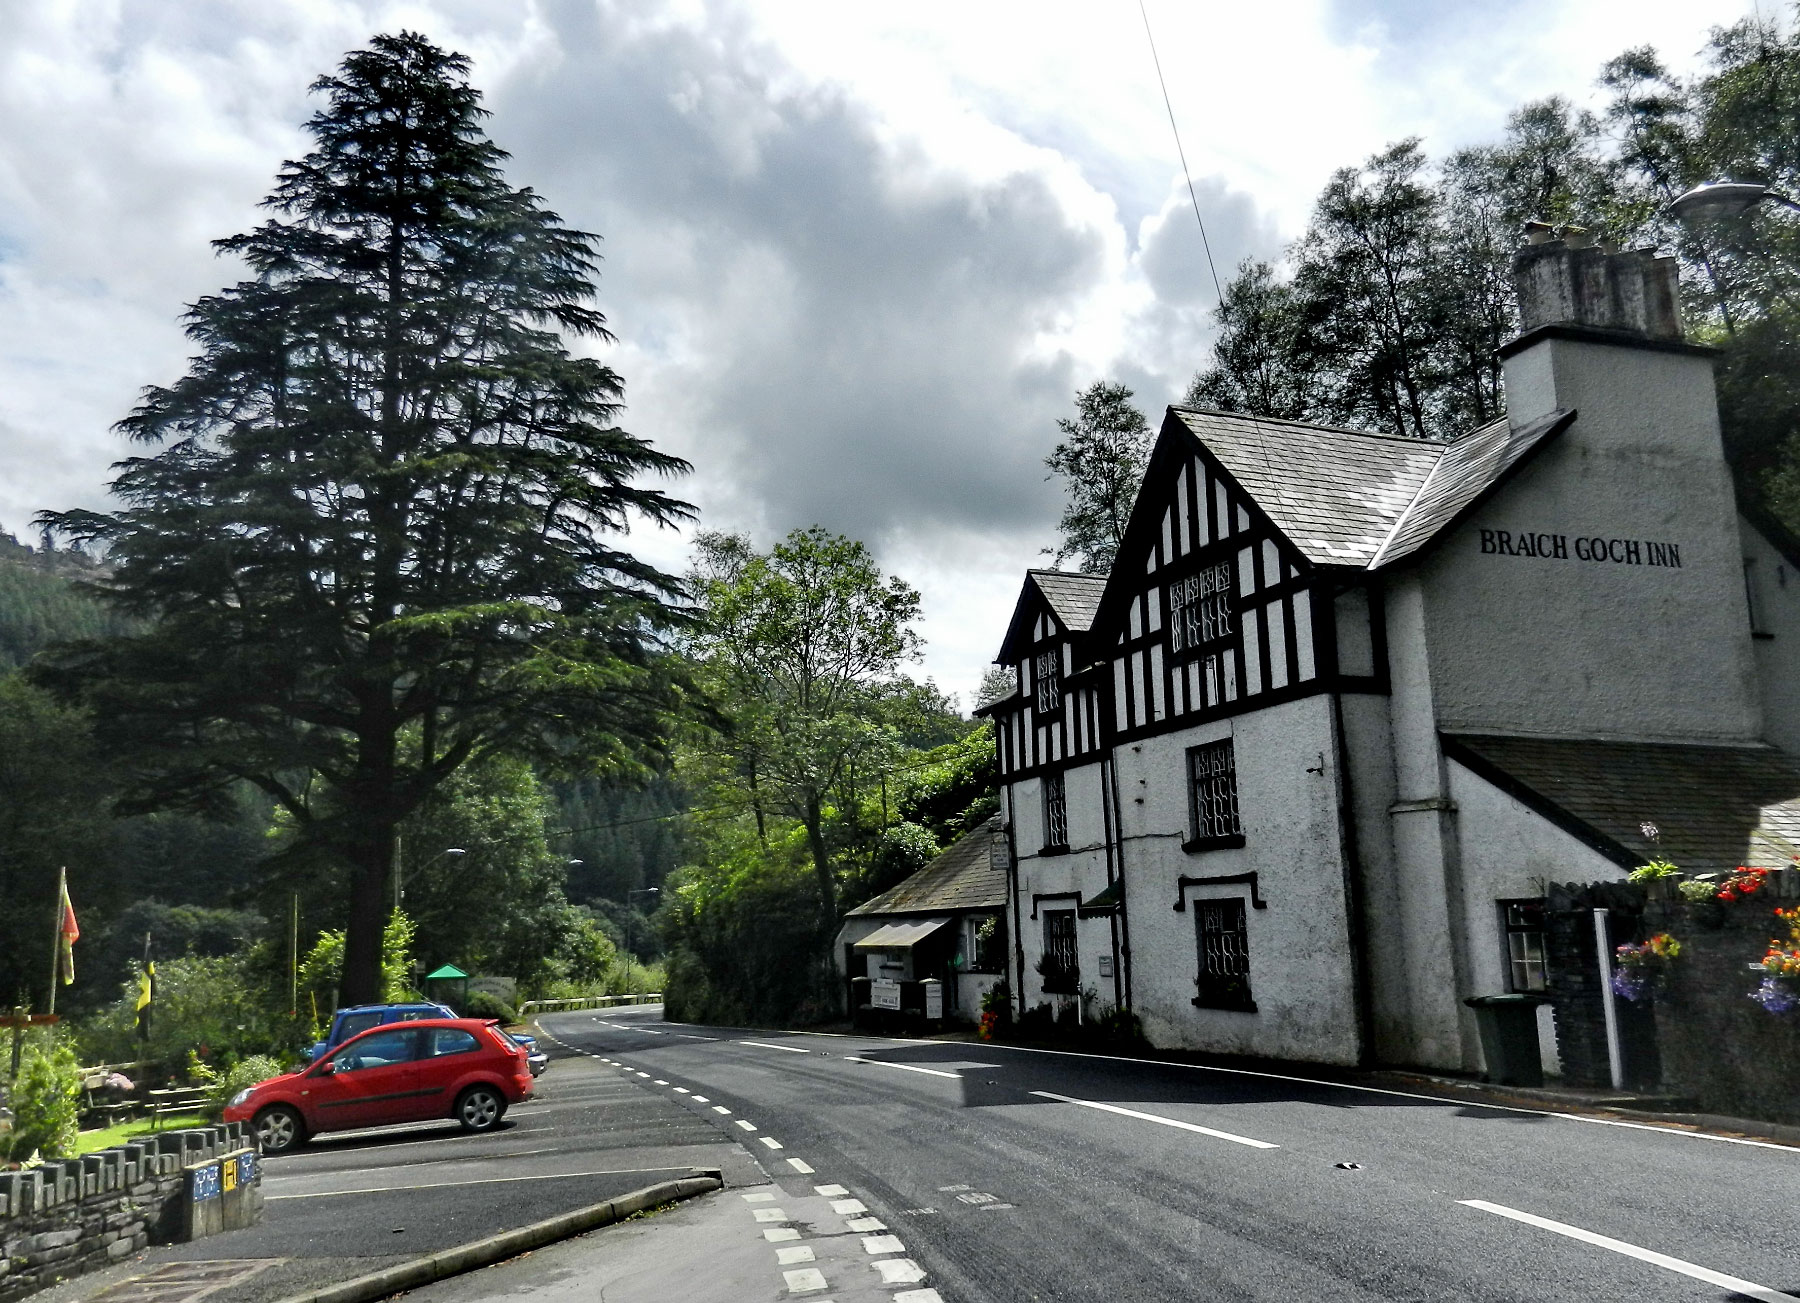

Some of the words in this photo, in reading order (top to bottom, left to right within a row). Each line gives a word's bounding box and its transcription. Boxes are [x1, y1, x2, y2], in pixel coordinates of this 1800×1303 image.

[1480, 529, 1568, 559] BRAICH
[1575, 537, 1642, 565] GOCH
[1645, 542, 1682, 568] INN
